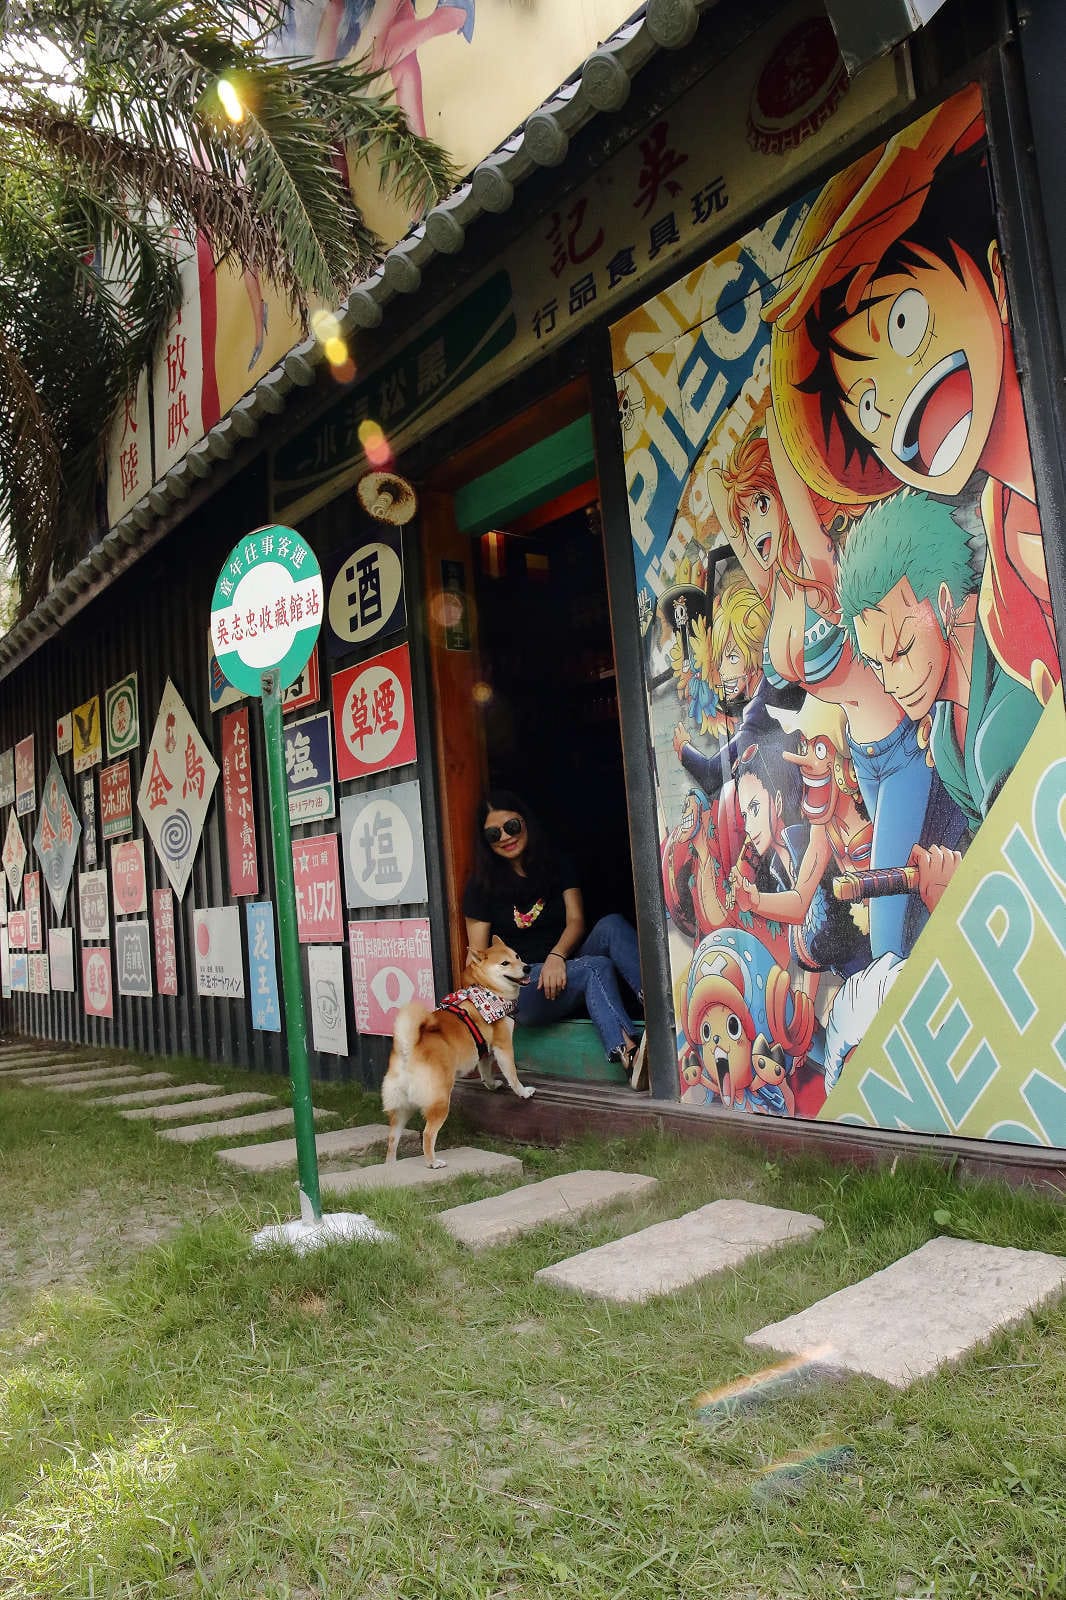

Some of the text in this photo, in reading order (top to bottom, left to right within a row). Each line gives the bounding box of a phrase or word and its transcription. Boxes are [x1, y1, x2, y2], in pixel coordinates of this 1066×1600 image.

[164, 305, 190, 449] 放映
[624, 203, 810, 557] PIECE
[216, 588, 320, 647] 吳志忠收藏館站
[345, 550, 383, 633] 酒
[146, 734, 206, 811] 金鳥
[359, 809, 403, 884] 塩
[834, 957, 1001, 1136] NE
